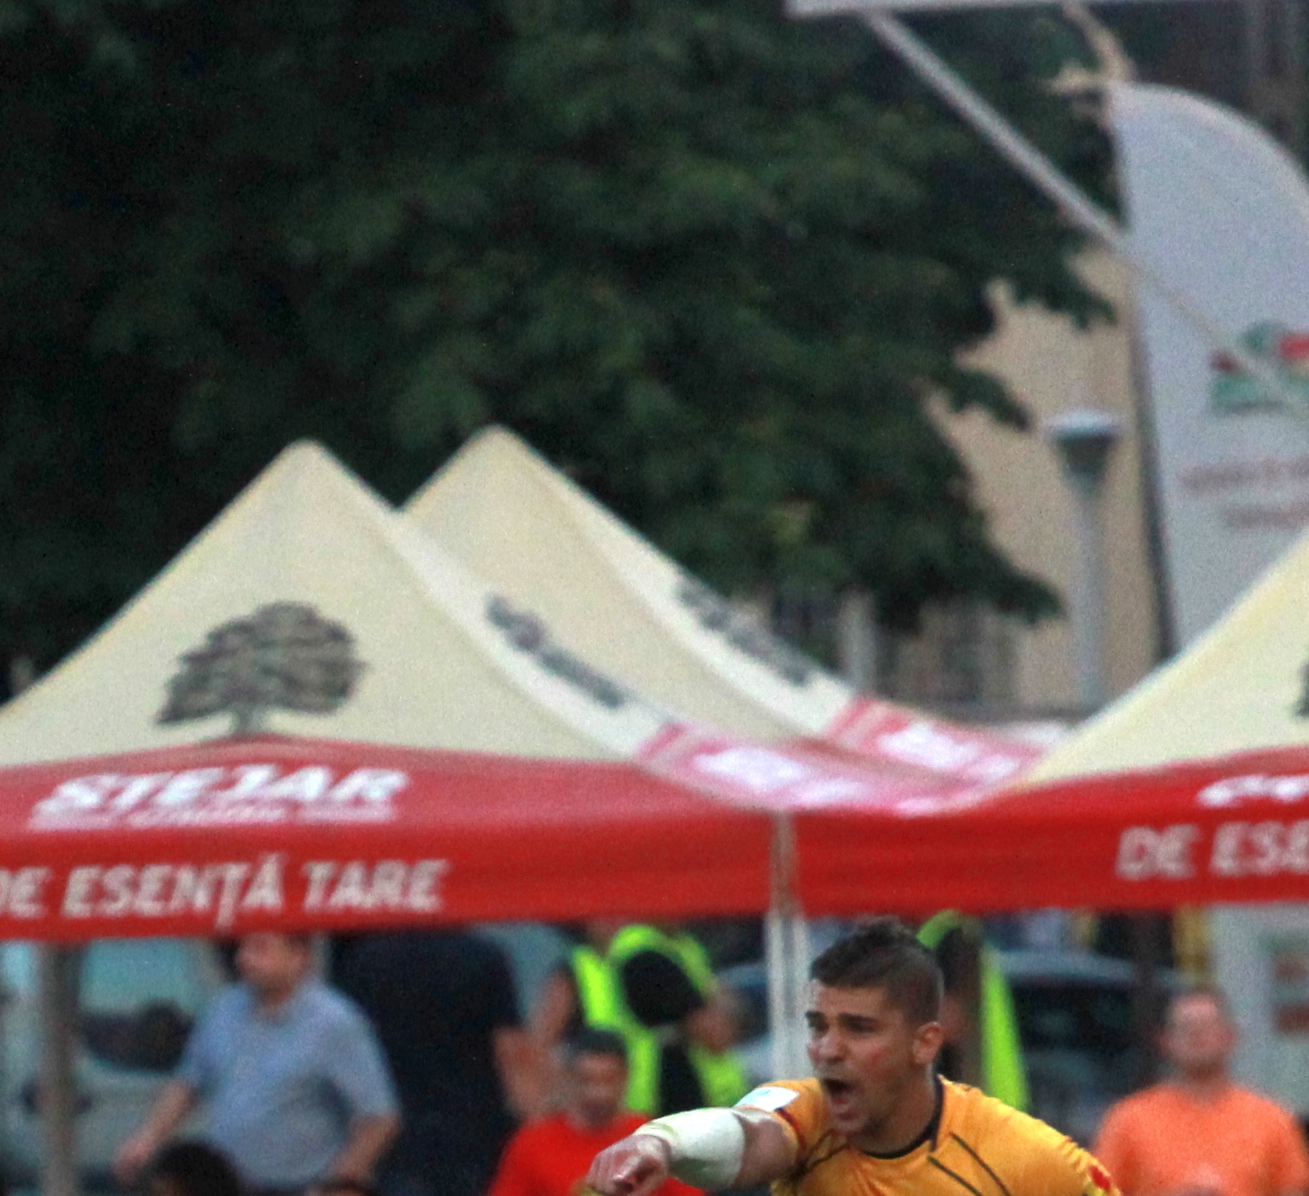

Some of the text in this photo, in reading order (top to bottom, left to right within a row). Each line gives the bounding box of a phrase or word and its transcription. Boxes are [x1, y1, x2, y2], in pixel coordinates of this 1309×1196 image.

[26, 763, 410, 825] STEJAR
[1114, 822, 1202, 881] DE
[302, 858, 450, 914] TARE
